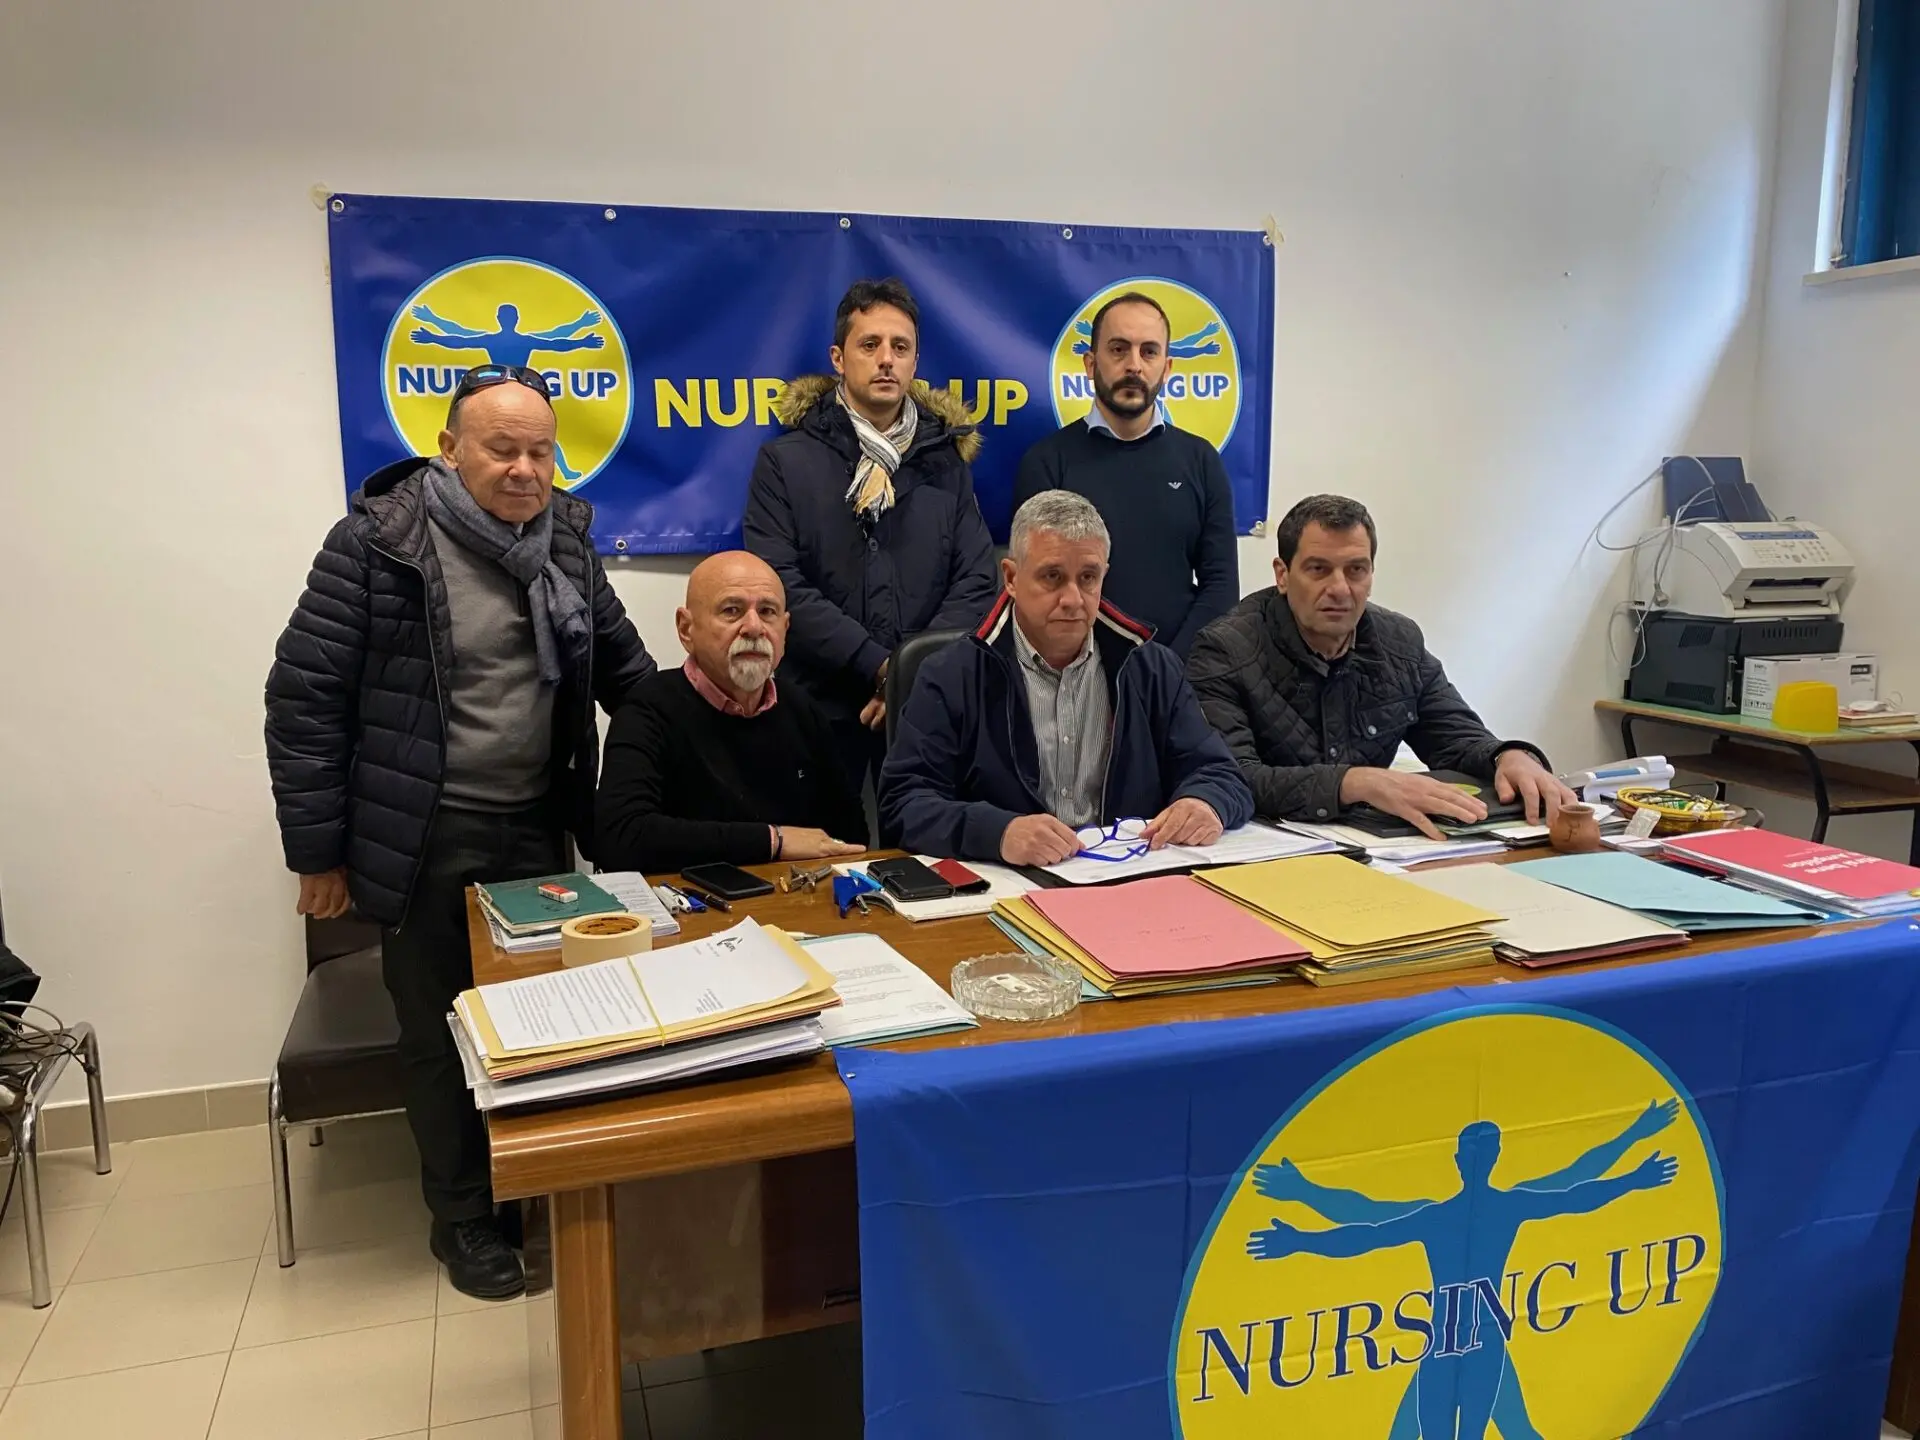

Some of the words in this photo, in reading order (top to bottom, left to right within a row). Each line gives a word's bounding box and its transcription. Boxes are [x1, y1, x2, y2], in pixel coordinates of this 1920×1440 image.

[572, 371, 617, 398] UP
[949, 378, 1029, 426] UP
[1192, 375, 1229, 398] UP
[1192, 1260, 1584, 1402] NURSING
[1606, 1234, 1706, 1316] UP
